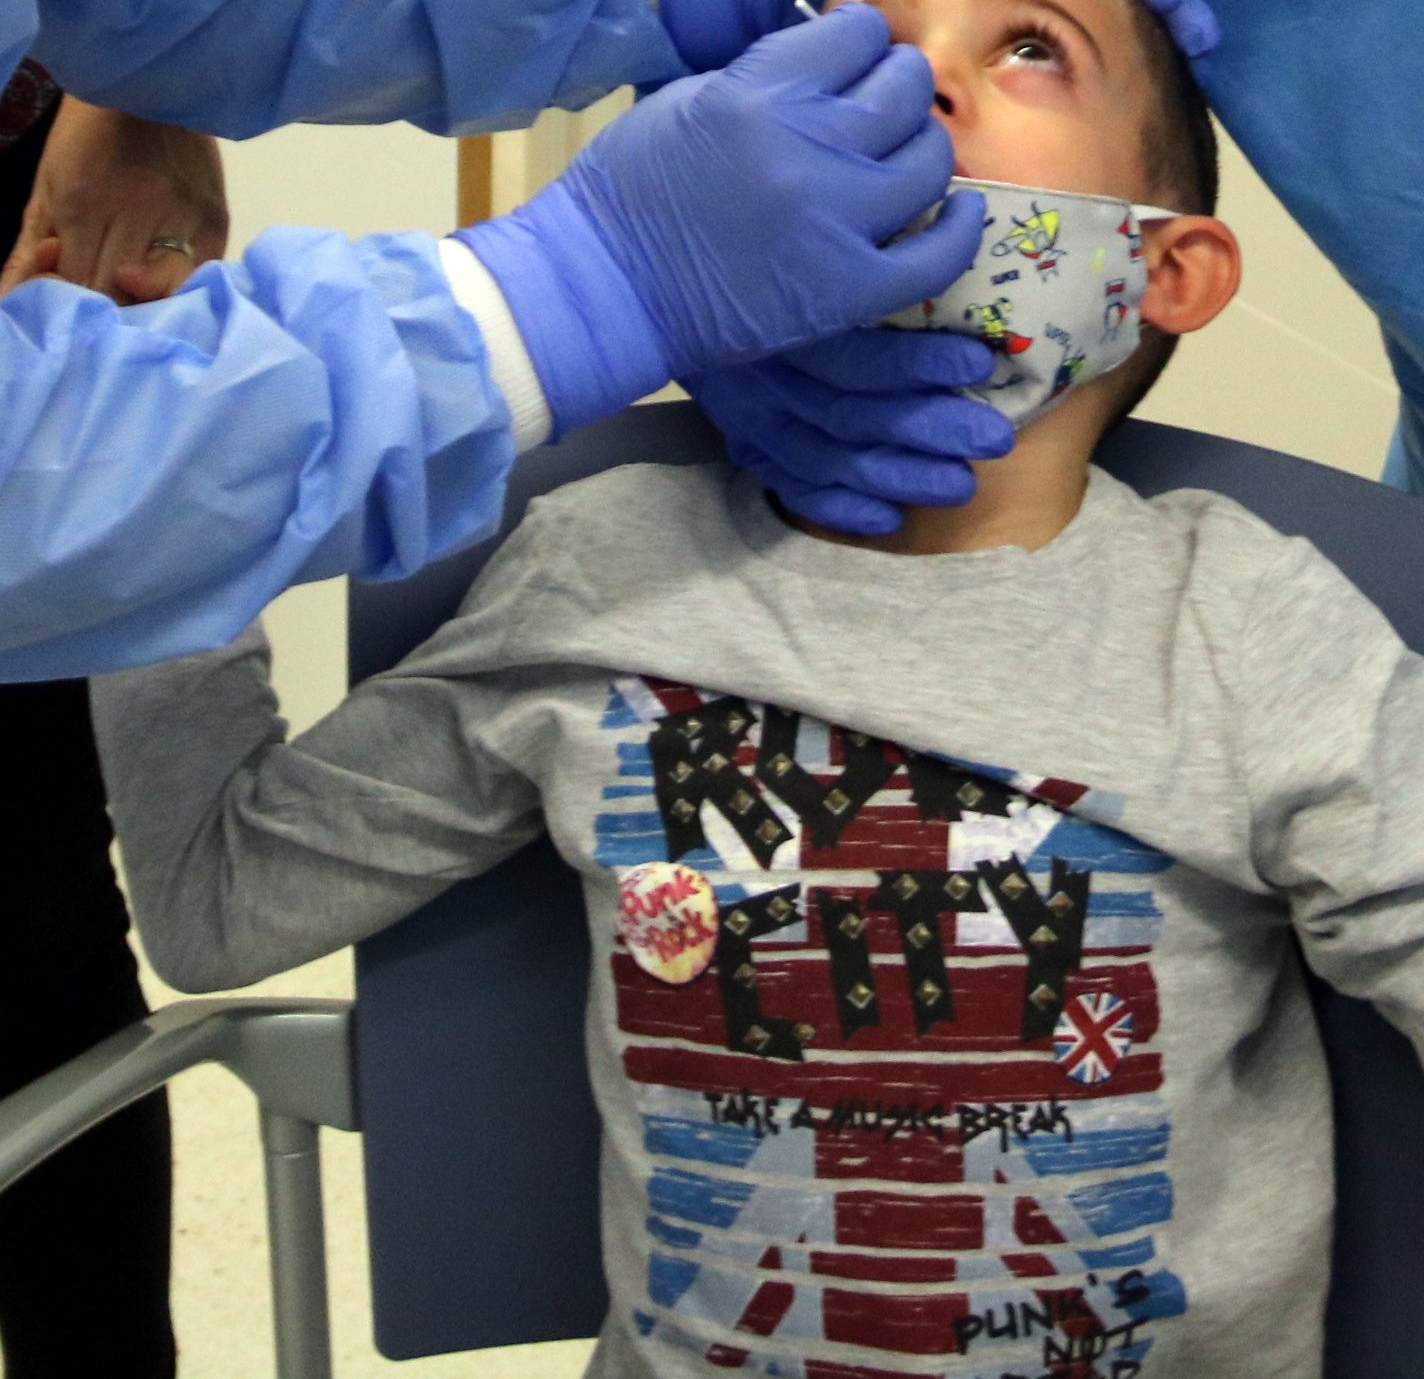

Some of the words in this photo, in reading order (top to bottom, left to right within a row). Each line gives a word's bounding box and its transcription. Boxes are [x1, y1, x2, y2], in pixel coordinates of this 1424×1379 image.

[716, 850, 1091, 1063] CITY
[703, 1088, 781, 1140] TAKE
[790, 1100, 814, 1129] A
[955, 1094, 1075, 1153] BREAK
[953, 1270, 1151, 1356] PUNK'S
[1044, 1317, 1149, 1368] NOT
